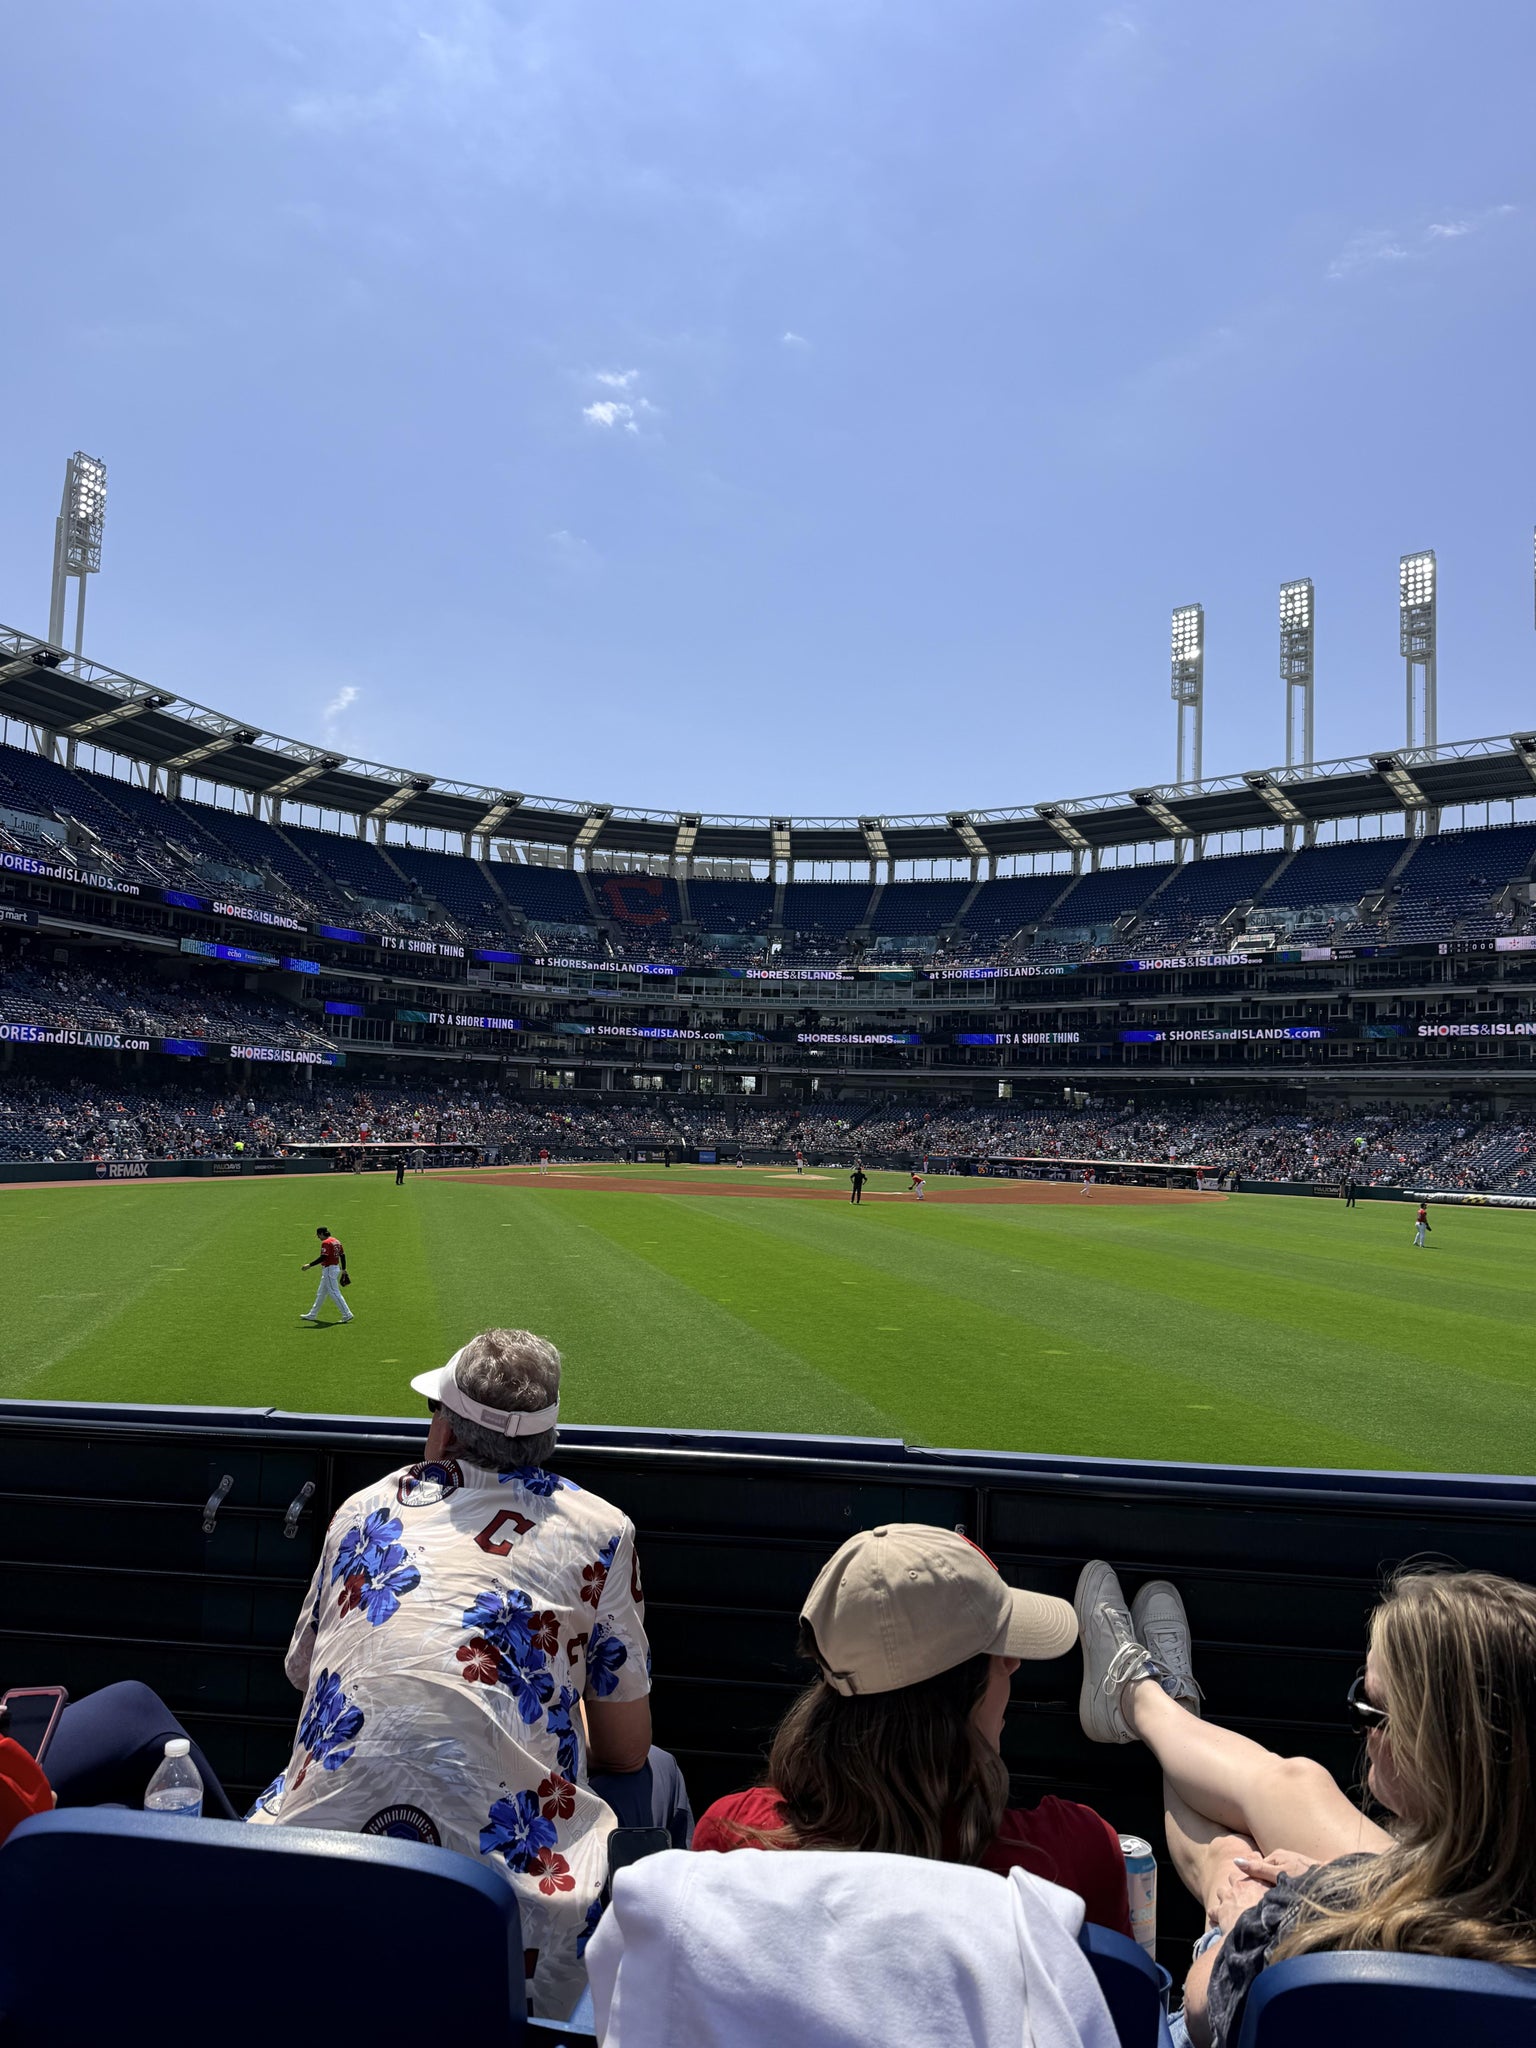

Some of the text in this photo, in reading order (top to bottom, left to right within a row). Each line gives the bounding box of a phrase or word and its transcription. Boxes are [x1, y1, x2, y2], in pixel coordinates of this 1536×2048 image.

[5, 911, 28, 922] mart
[381, 935, 465, 958] IT'S A SHORE THING
[534, 957, 673, 976] at SHORESandISLANDS.com
[930, 965, 1064, 980] at SHORESandISLANDS.com
[429, 1012, 514, 1030] IT'S A SHORE THING
[585, 1025, 724, 1040] at SHORESandISLANDS.com
[996, 1032, 1079, 1045] IT'S A SHORE THING
[1155, 1028, 1321, 1041] at SHORESandISLANDS.com
[473, 1509, 536, 1556] C
